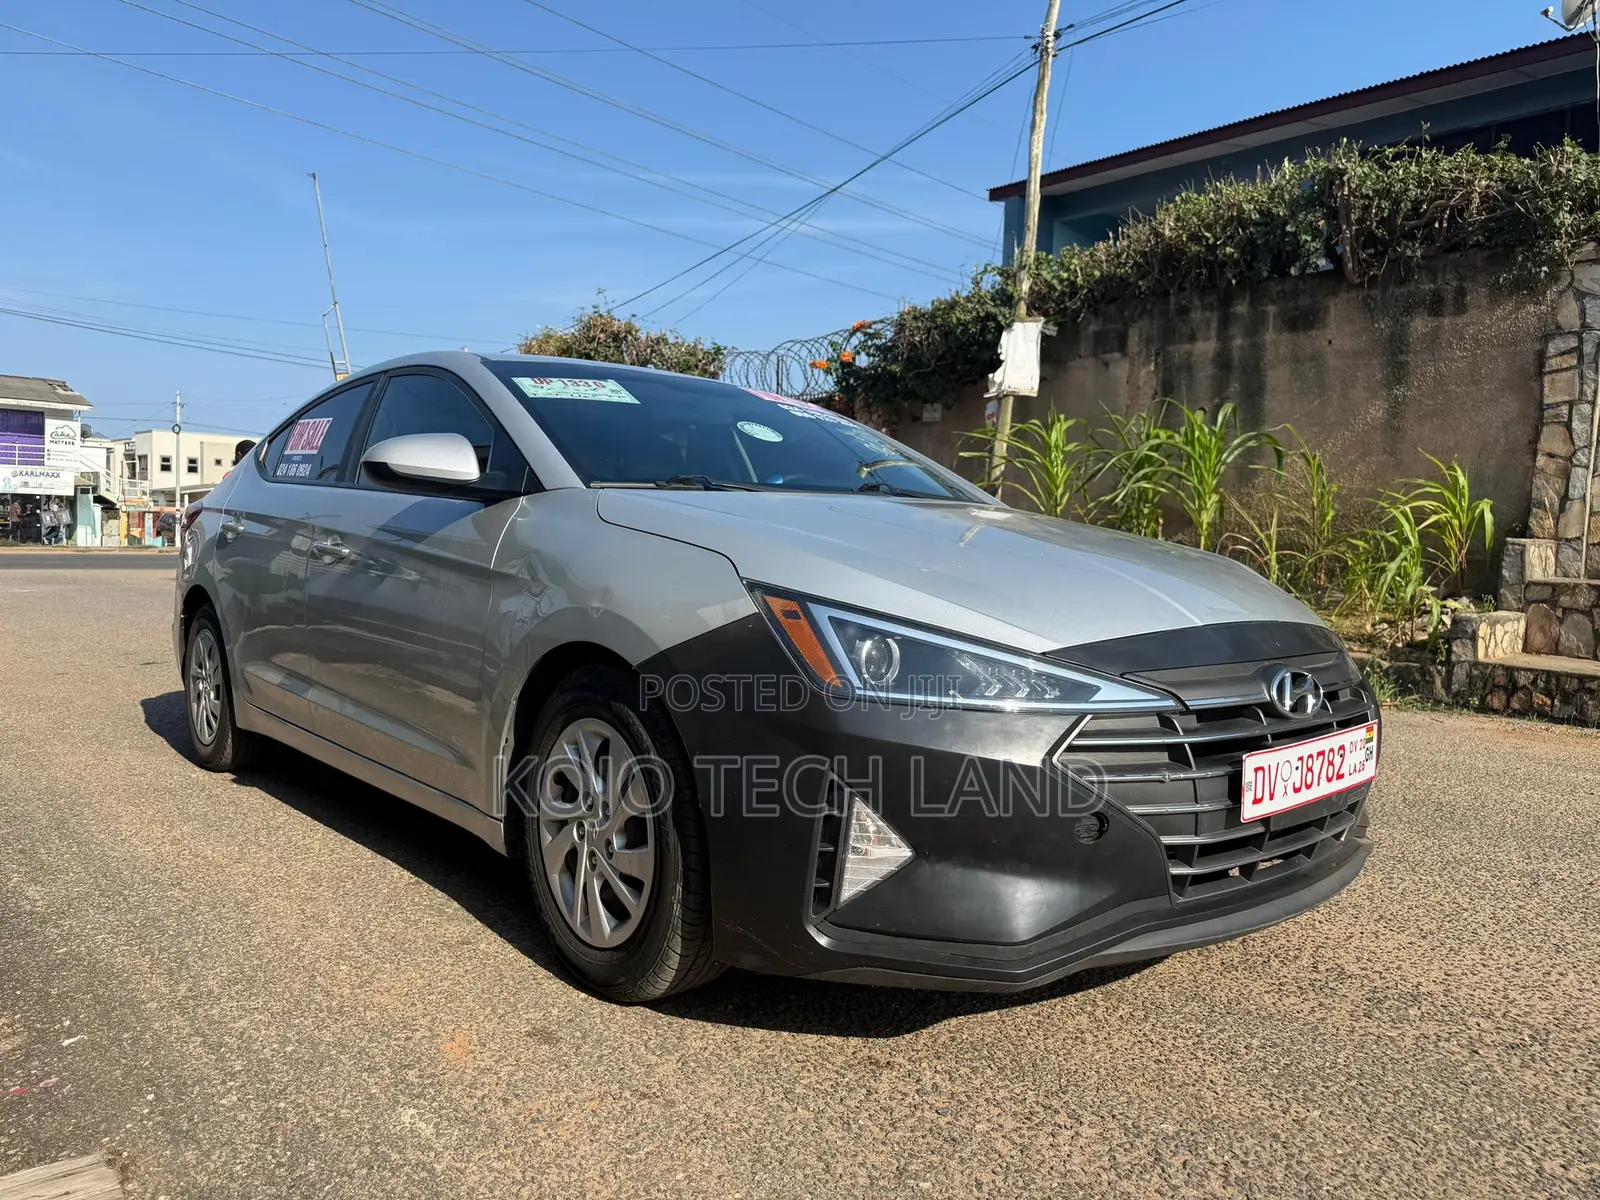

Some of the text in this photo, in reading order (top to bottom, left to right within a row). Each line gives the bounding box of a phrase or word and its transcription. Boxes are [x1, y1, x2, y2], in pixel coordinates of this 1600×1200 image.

[300, 420, 332, 450] SALE
[19, 470, 60, 479] KARLMAXX
[1252, 744, 1346, 805] DV J8782
